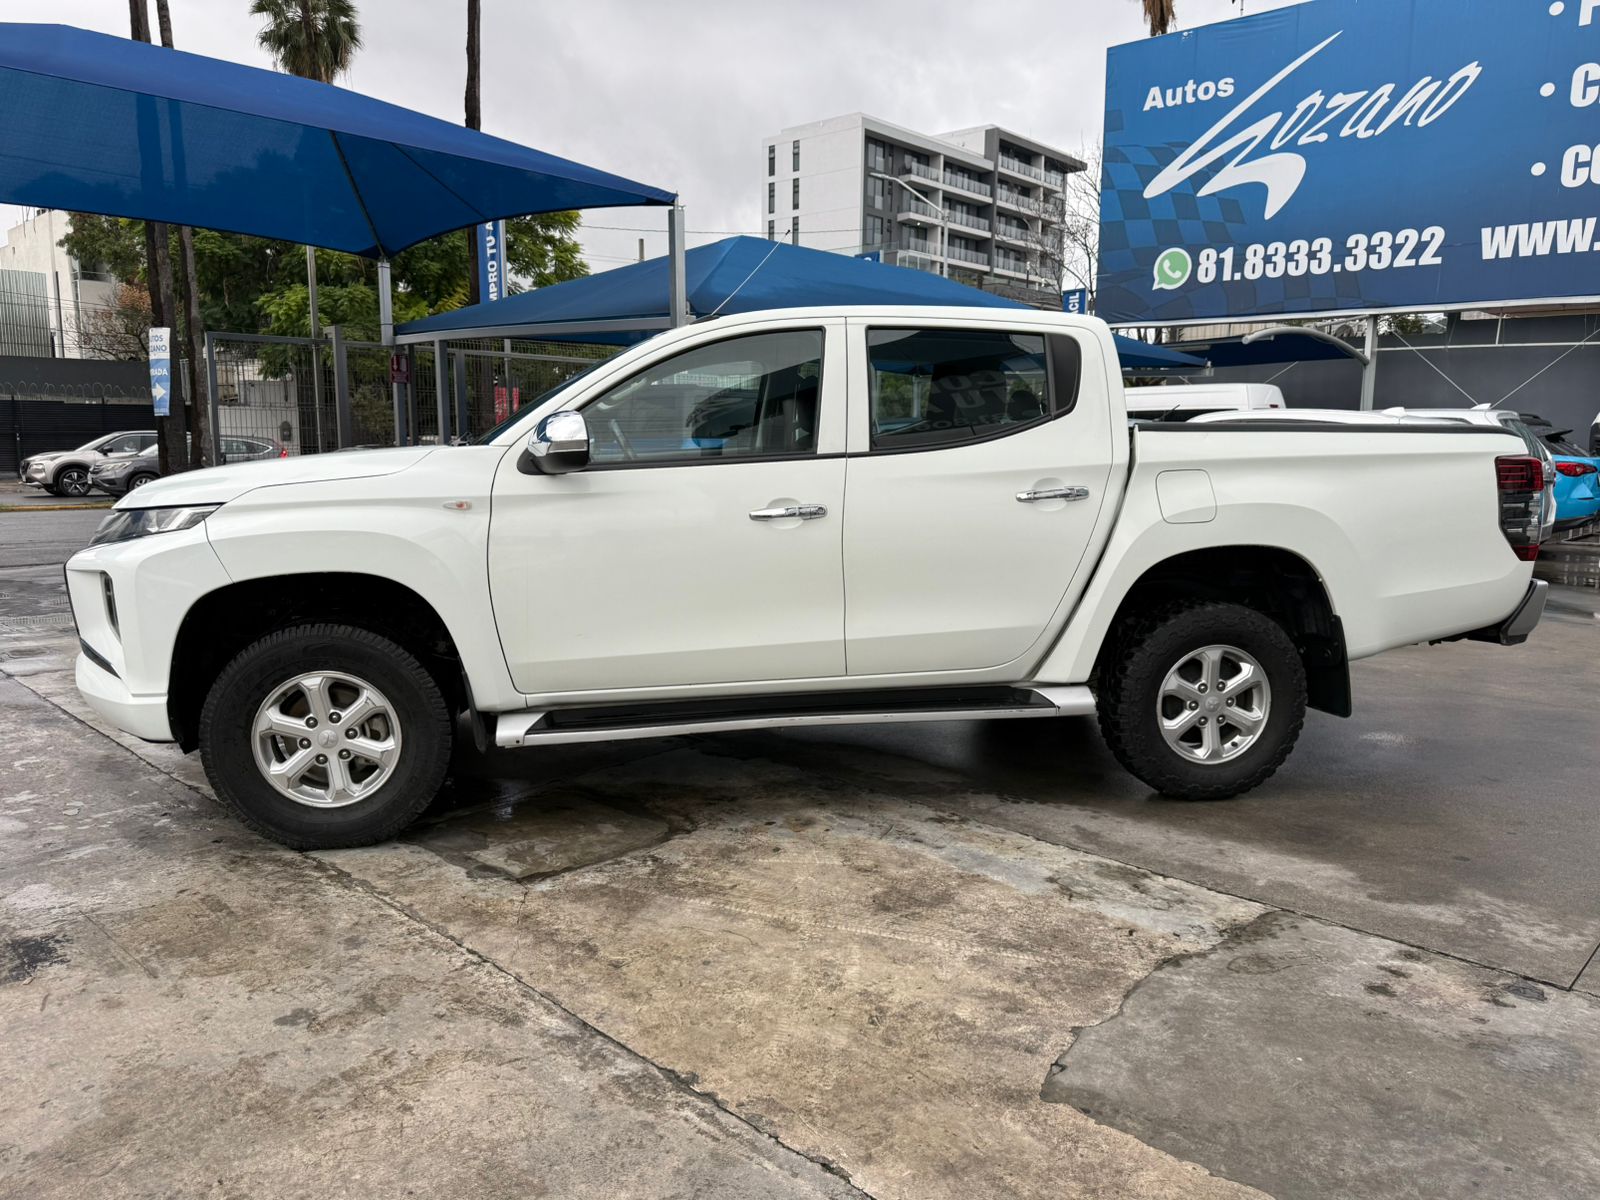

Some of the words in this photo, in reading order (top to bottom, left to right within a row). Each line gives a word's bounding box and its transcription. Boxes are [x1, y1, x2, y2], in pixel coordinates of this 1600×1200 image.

[1143, 77, 1234, 111] Autos
[486, 235, 497, 257] TU
[1197, 225, 1445, 284] 81.8333.3322
